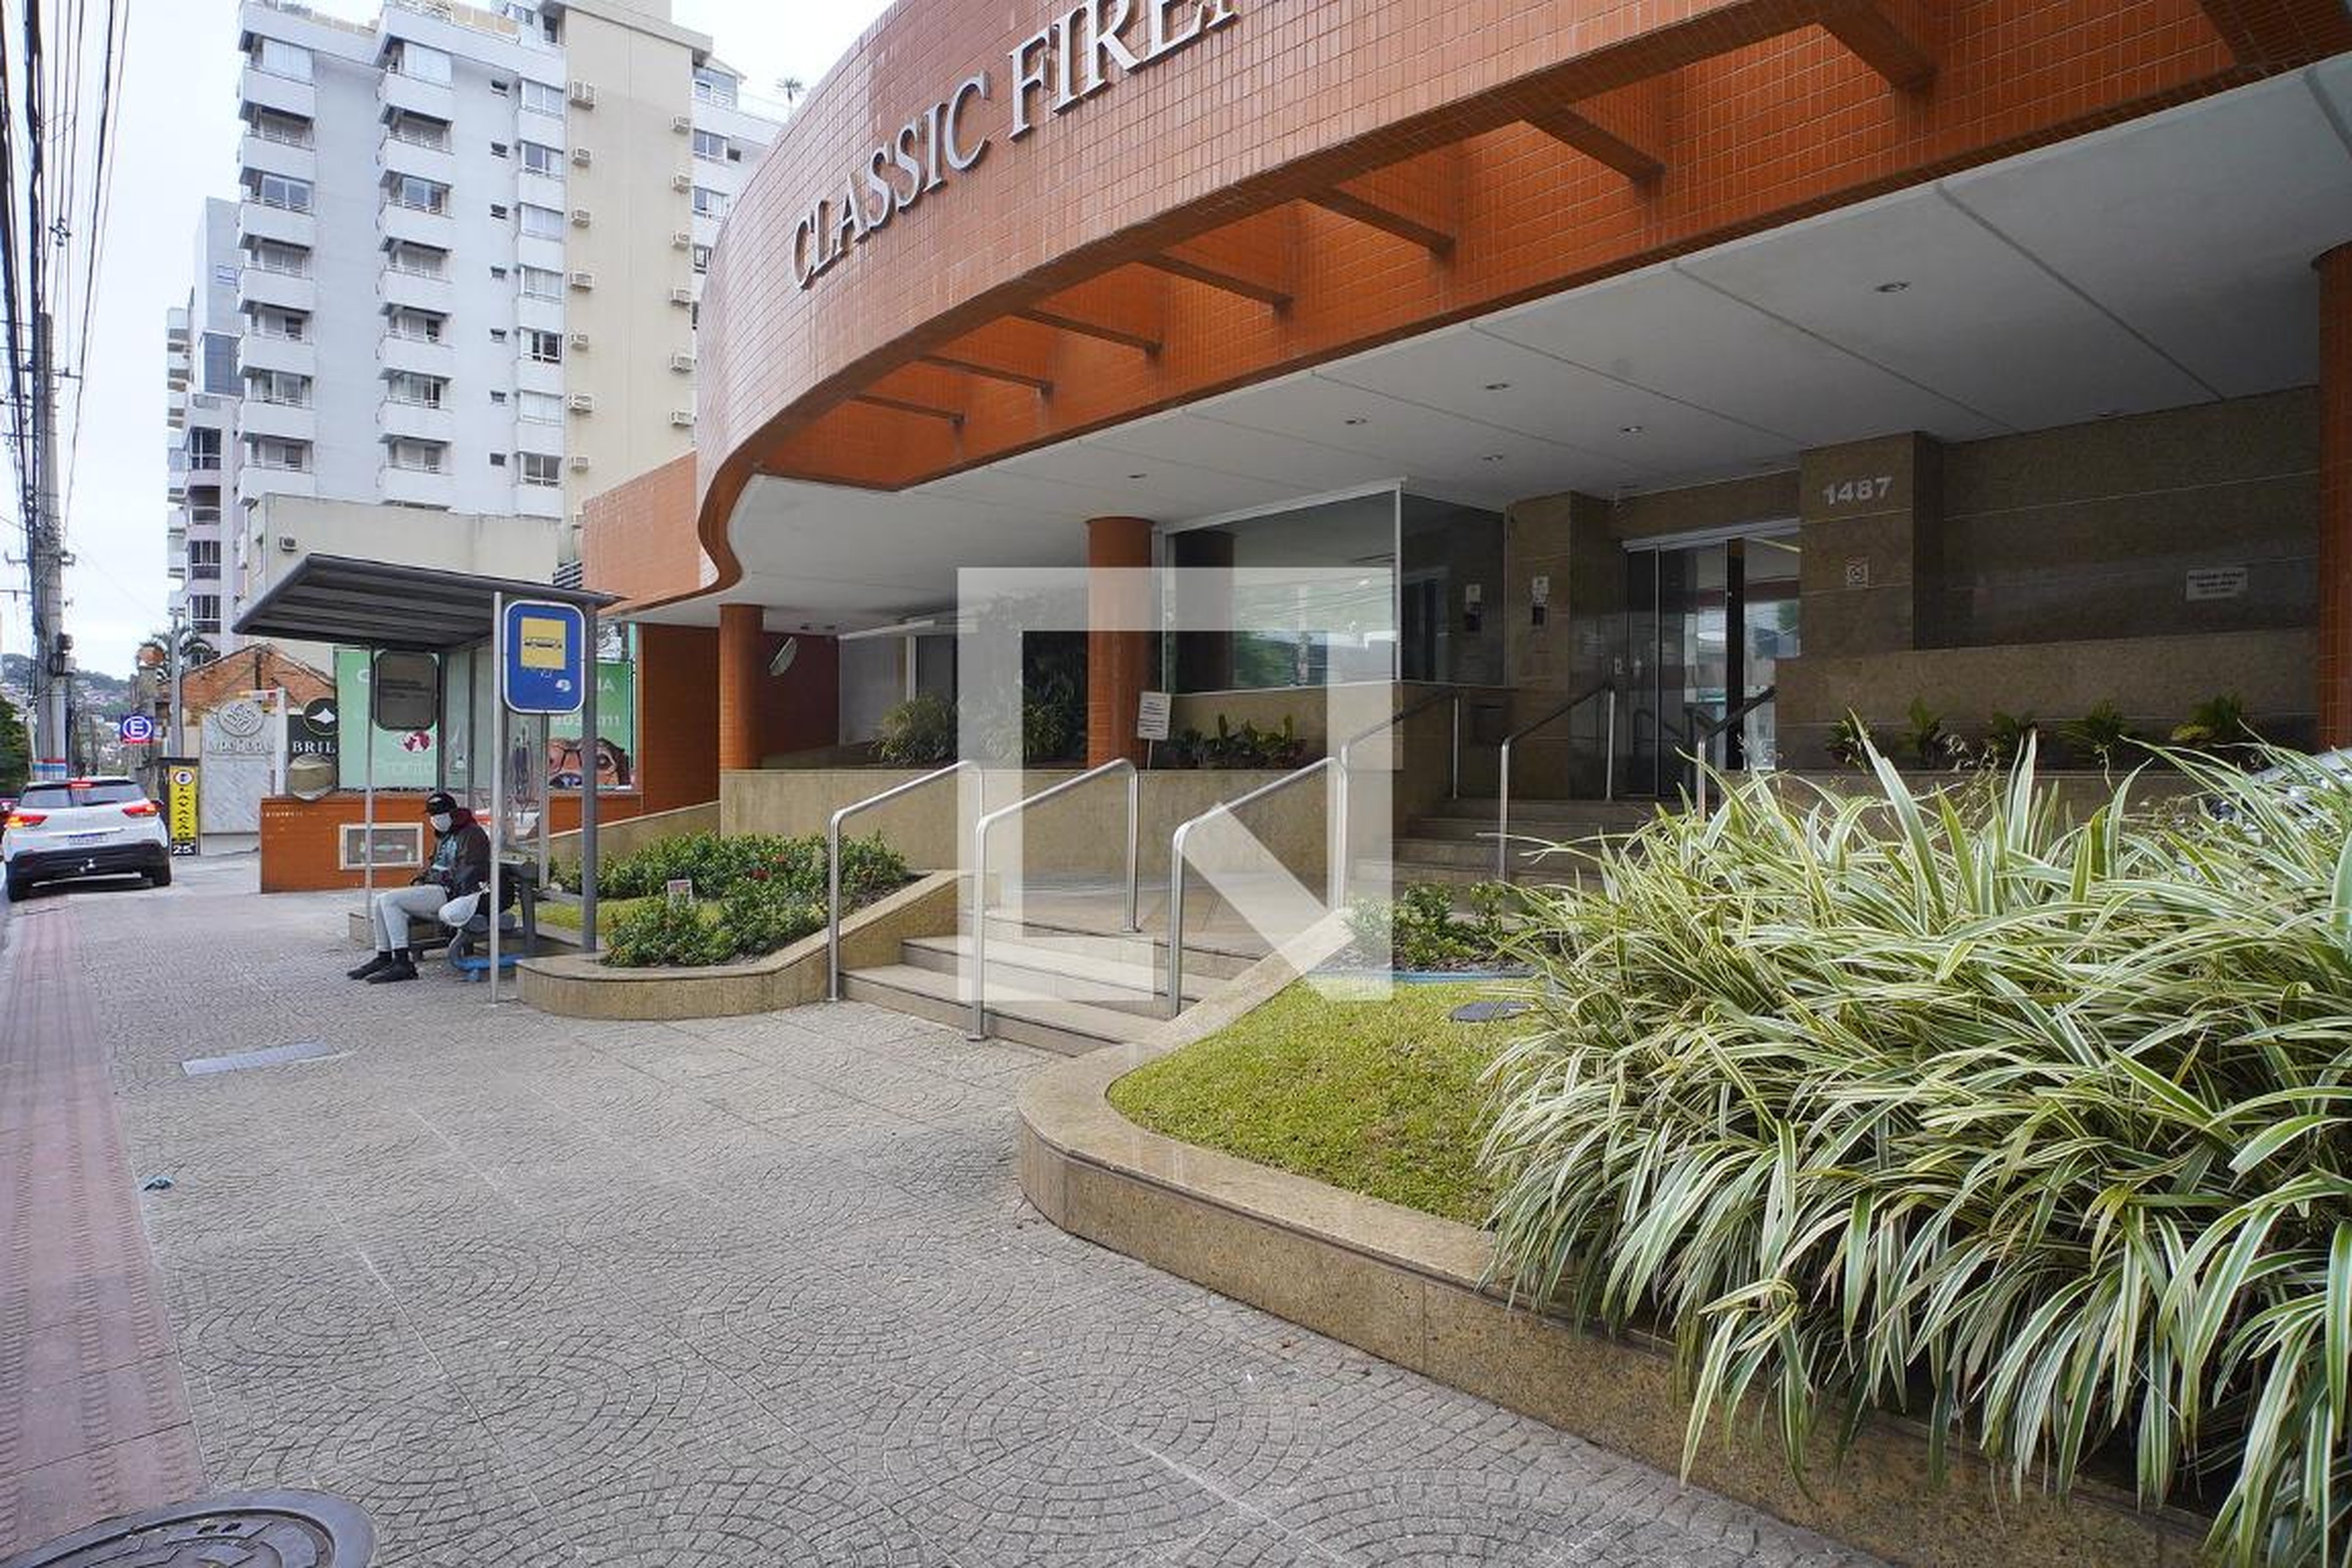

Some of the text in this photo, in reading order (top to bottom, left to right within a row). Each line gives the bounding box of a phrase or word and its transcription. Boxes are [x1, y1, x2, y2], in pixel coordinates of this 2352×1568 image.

[793, 0, 1238, 288] CLASSIC FIRE
[1822, 476, 1893, 505] 1487
[130, 721, 144, 734] E
